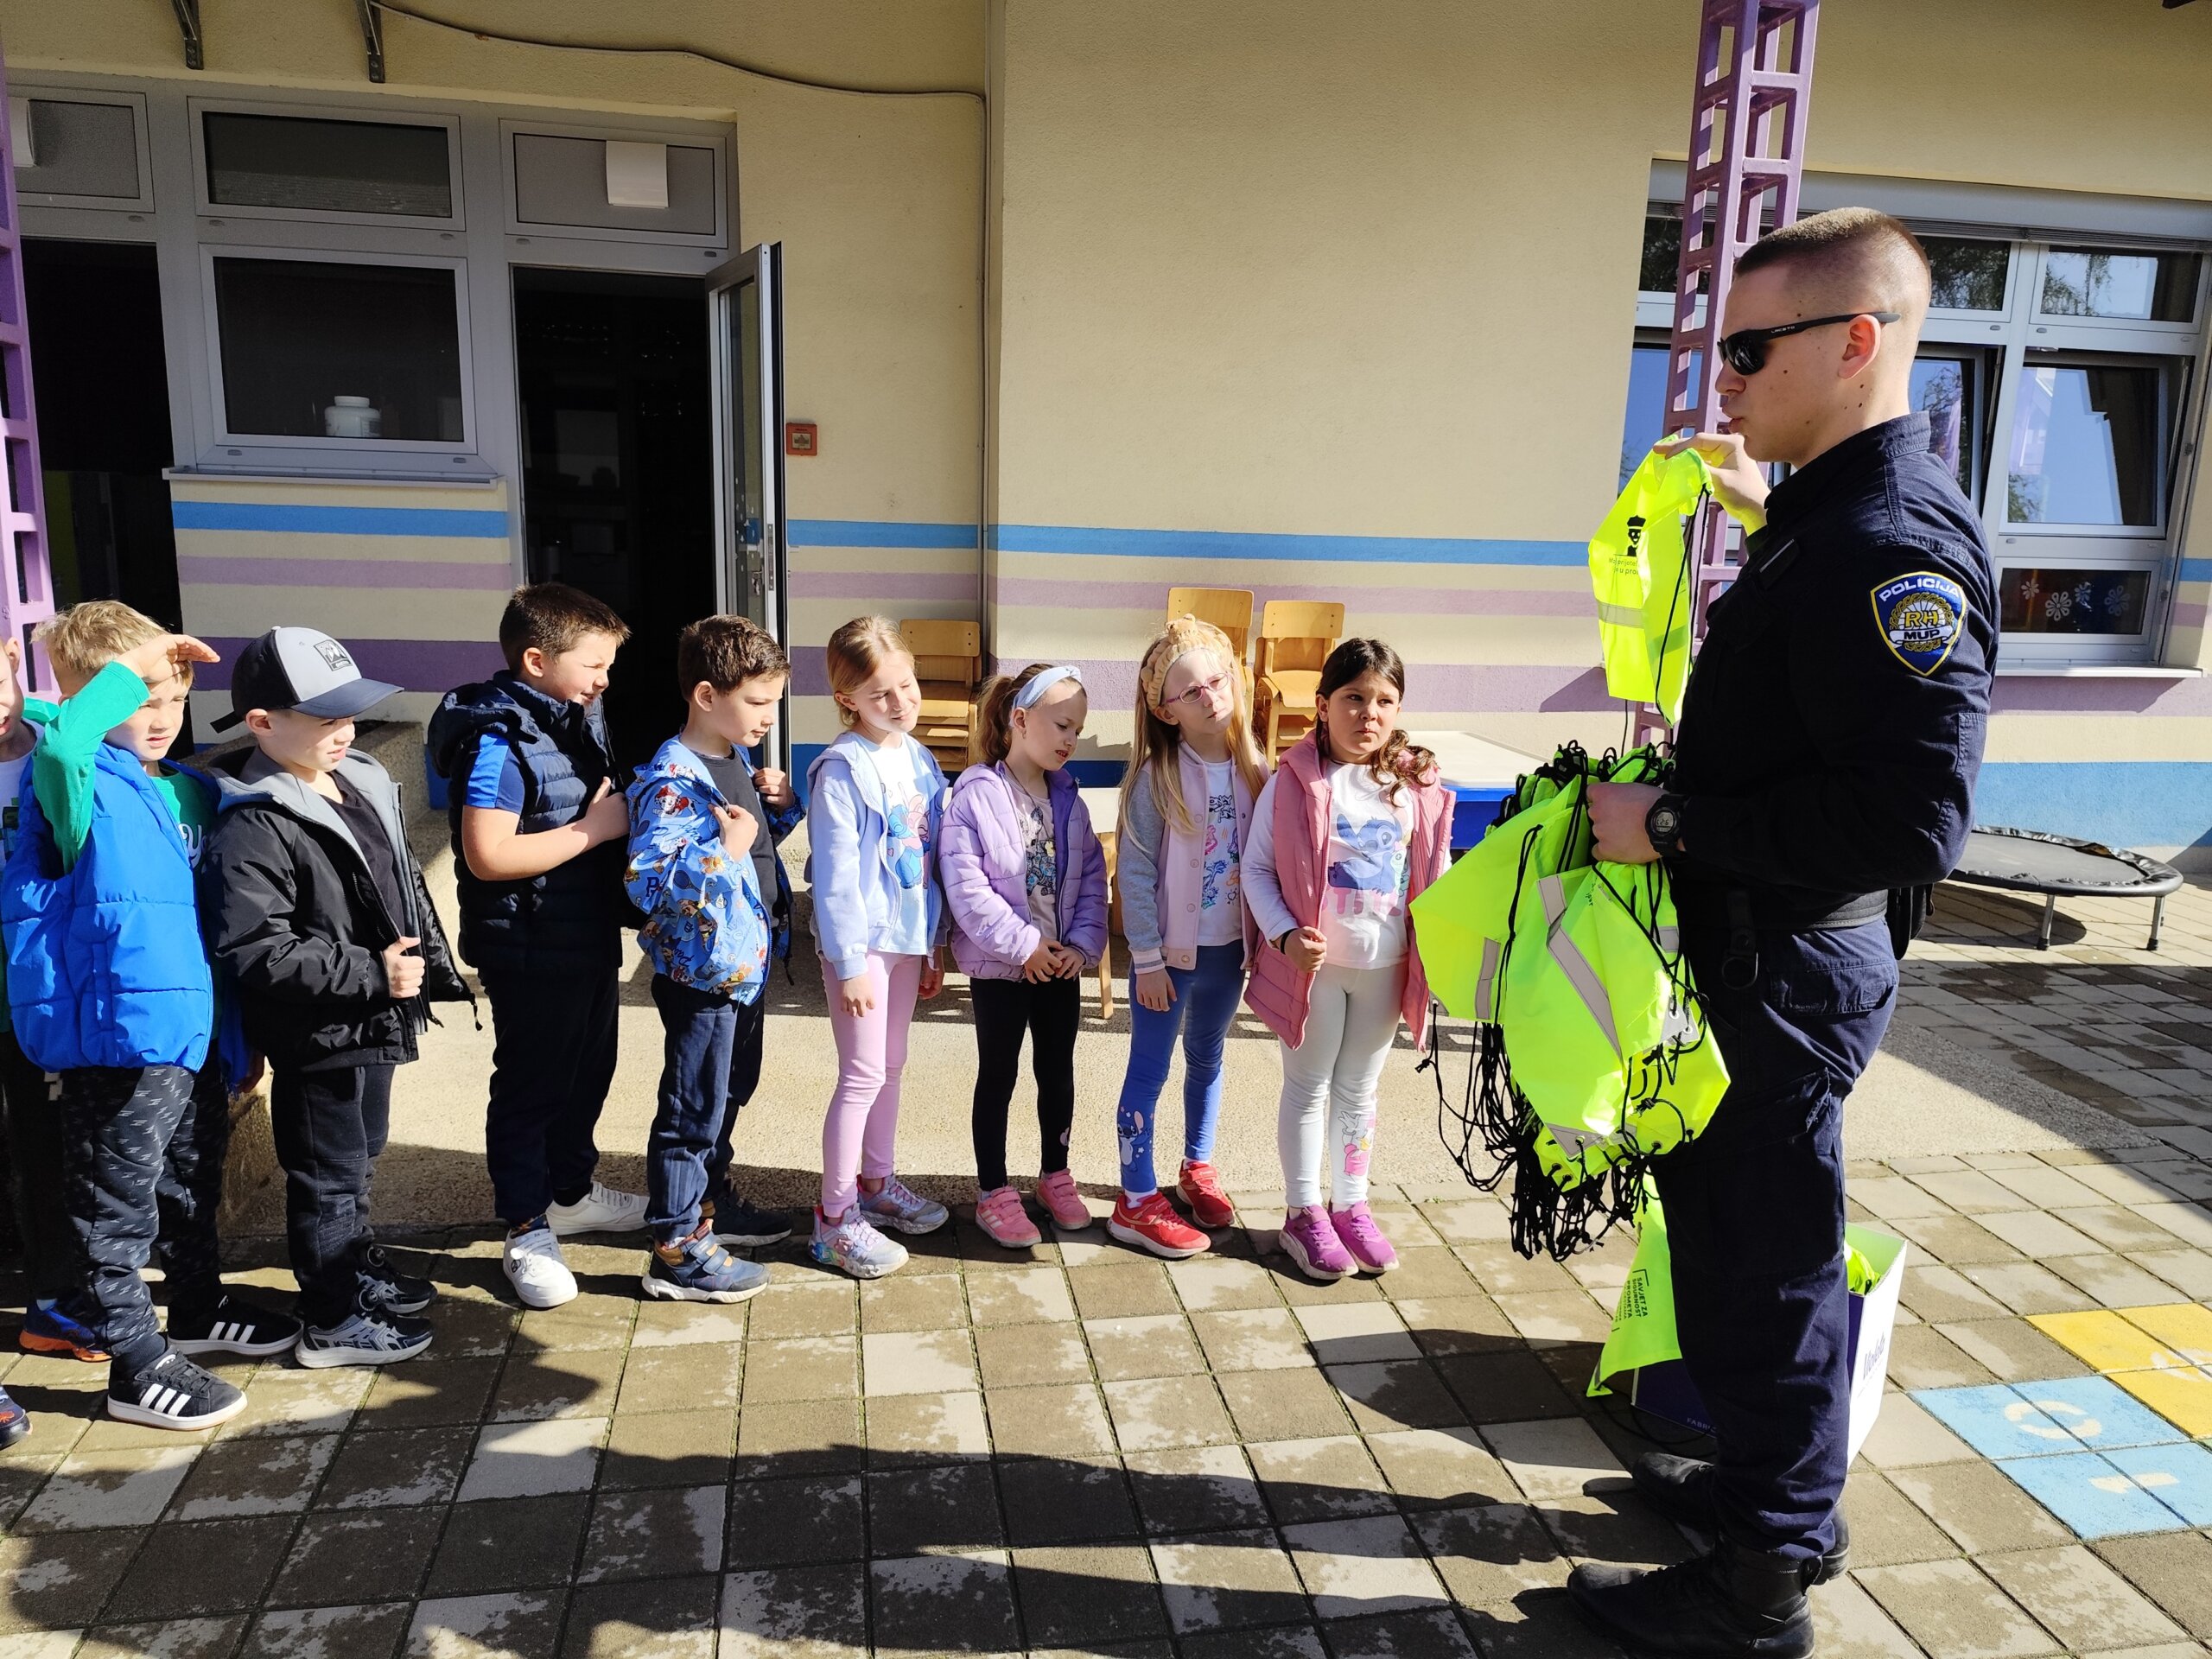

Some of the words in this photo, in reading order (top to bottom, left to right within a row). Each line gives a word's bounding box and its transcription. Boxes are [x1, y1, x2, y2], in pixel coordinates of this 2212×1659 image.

[1878, 577, 1960, 602] POLICIJA
[1904, 610, 1940, 628] RH
[1904, 628, 1941, 640] MUP
[1631, 1278, 1642, 1318] SIGURNOST
[1637, 1277, 1647, 1305] SAVJET
[1641, 1306, 1649, 1317] ZA
